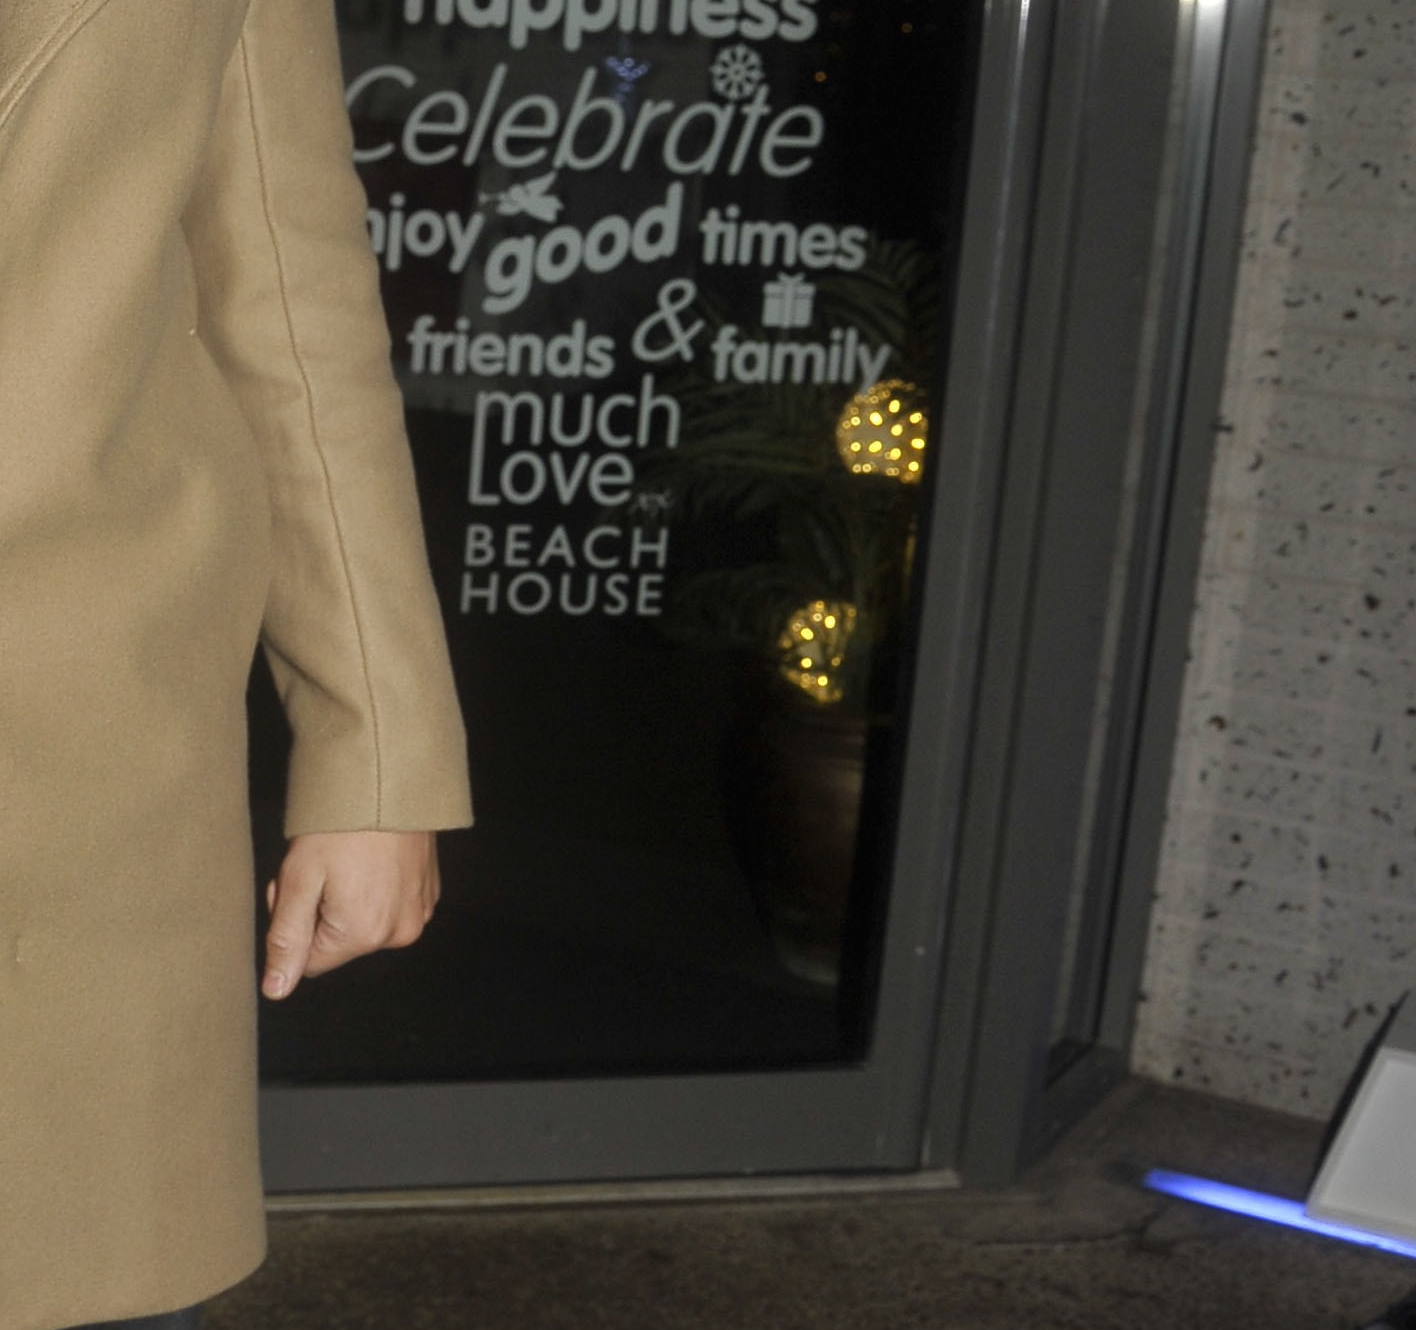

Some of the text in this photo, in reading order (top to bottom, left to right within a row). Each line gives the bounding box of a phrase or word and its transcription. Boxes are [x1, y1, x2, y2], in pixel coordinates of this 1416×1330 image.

[346, 62, 824, 178] Celebrate
[482, 181, 684, 316] good
[698, 204, 868, 271] times
[406, 277, 892, 396] friends & family
[471, 373, 681, 451] much
[468, 441, 634, 507] Love
[464, 523, 669, 569] BEACH
[459, 571, 664, 616] HOUSE
